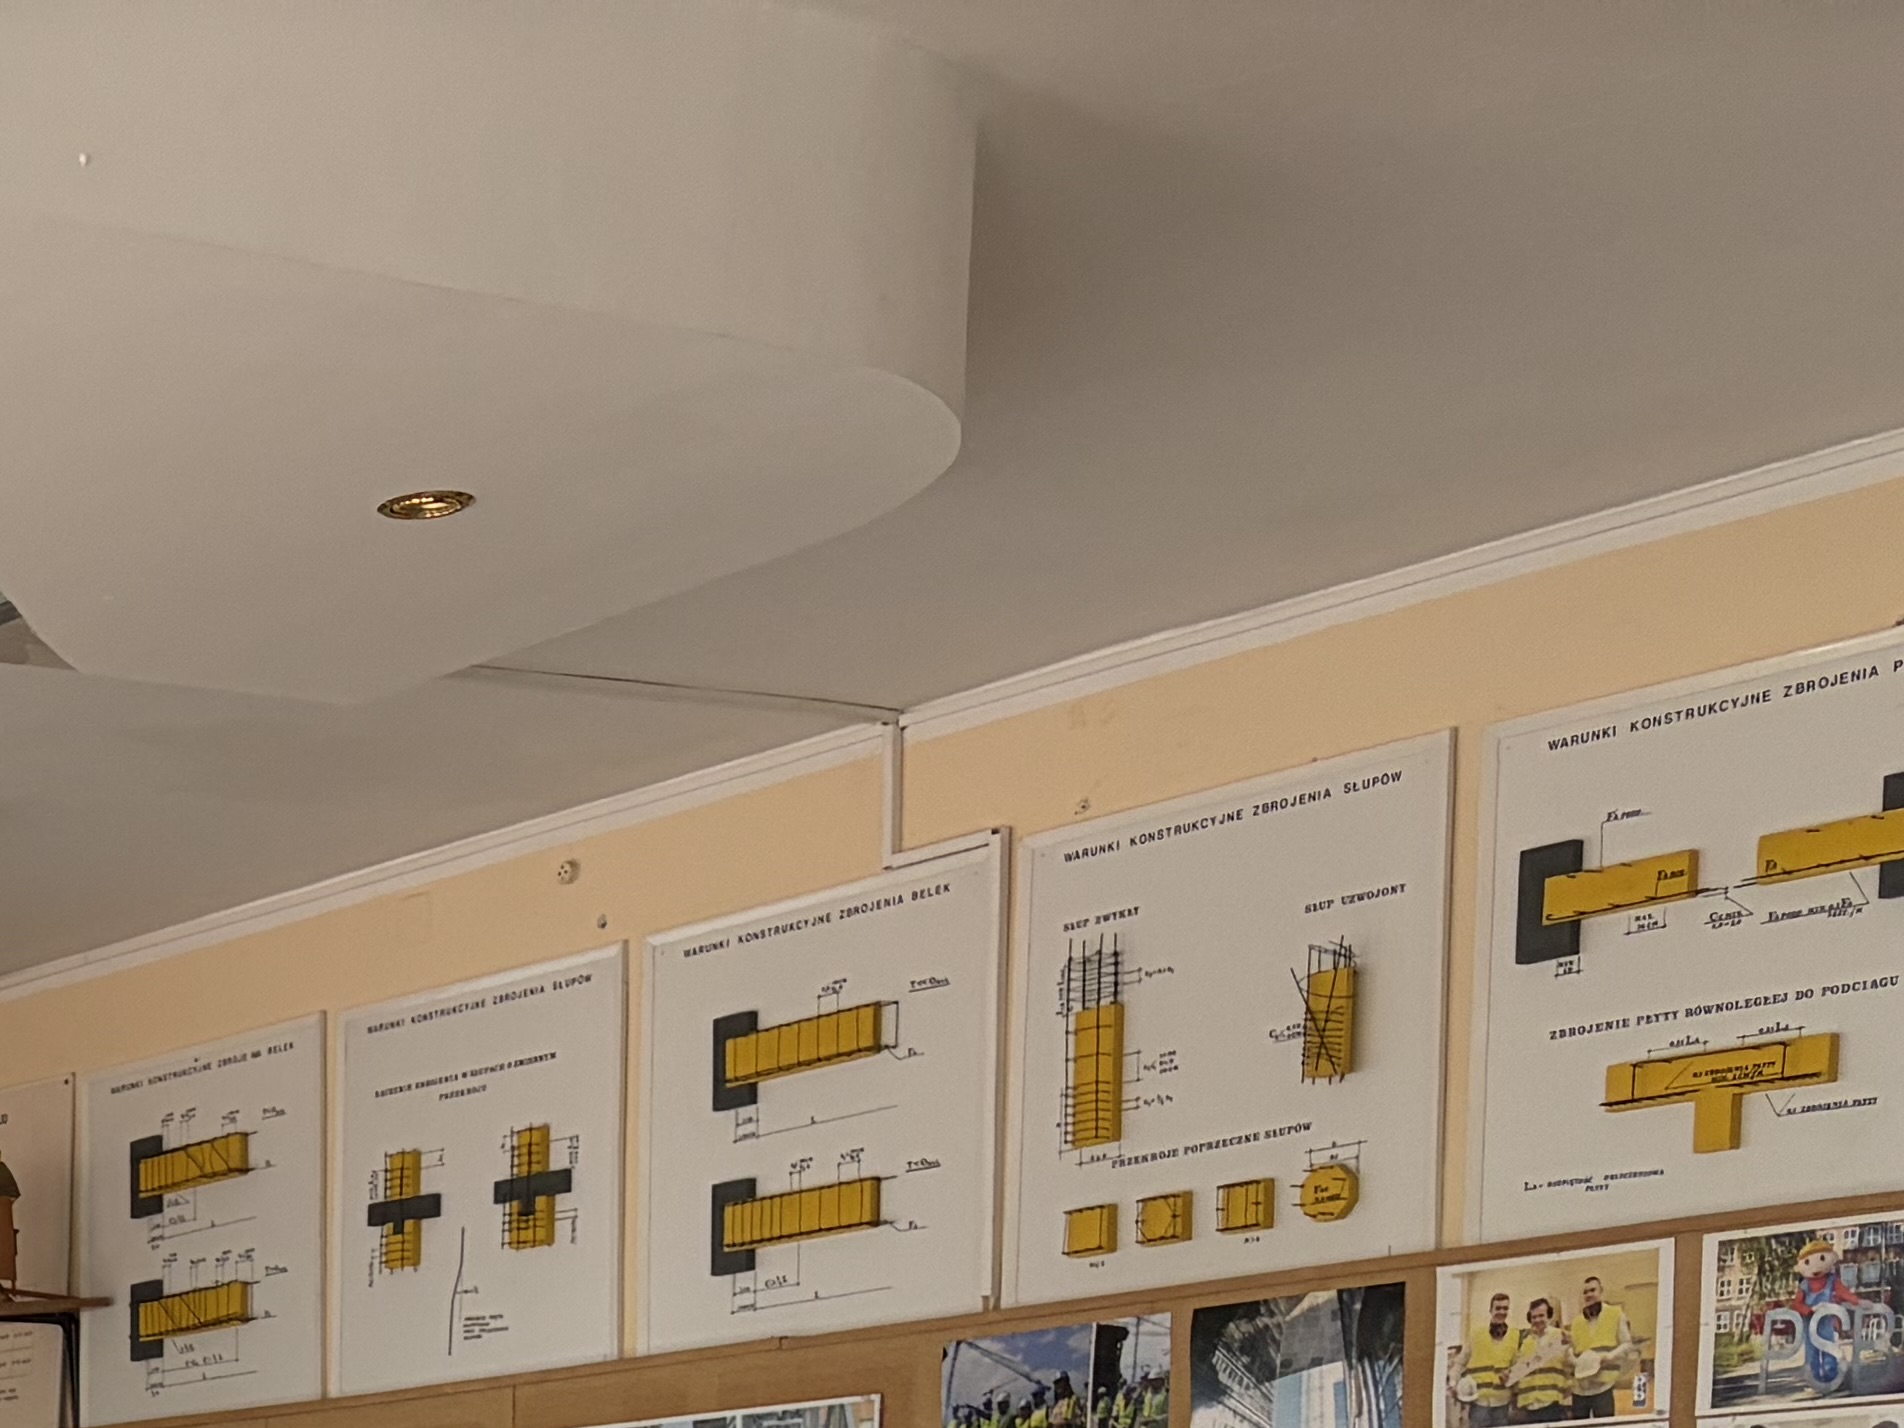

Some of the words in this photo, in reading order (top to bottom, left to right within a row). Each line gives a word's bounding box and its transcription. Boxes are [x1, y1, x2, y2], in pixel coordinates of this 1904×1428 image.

[1548, 725, 1617, 751] WARUNKI
[1630, 689, 1772, 733] KONSTRUKCYJNE
[1783, 665, 1880, 698] ZBROJENIA
[1064, 840, 1121, 863] WARUNKI
[1129, 809, 1244, 847] KONSTRUKCYJNE
[1252, 787, 1332, 817] ZBROJENIA
[1343, 770, 1403, 795] SŁUPÓW
[683, 938, 730, 958] WARUNKI
[737, 912, 832, 945] KONSTRUKCYJNE
[839, 894, 904, 920] ZBROJENIA
[911, 883, 951, 901] BELEK
[1549, 1018, 1630, 1041] ZBROJENIE
[1795, 988, 1814, 1001] DO
